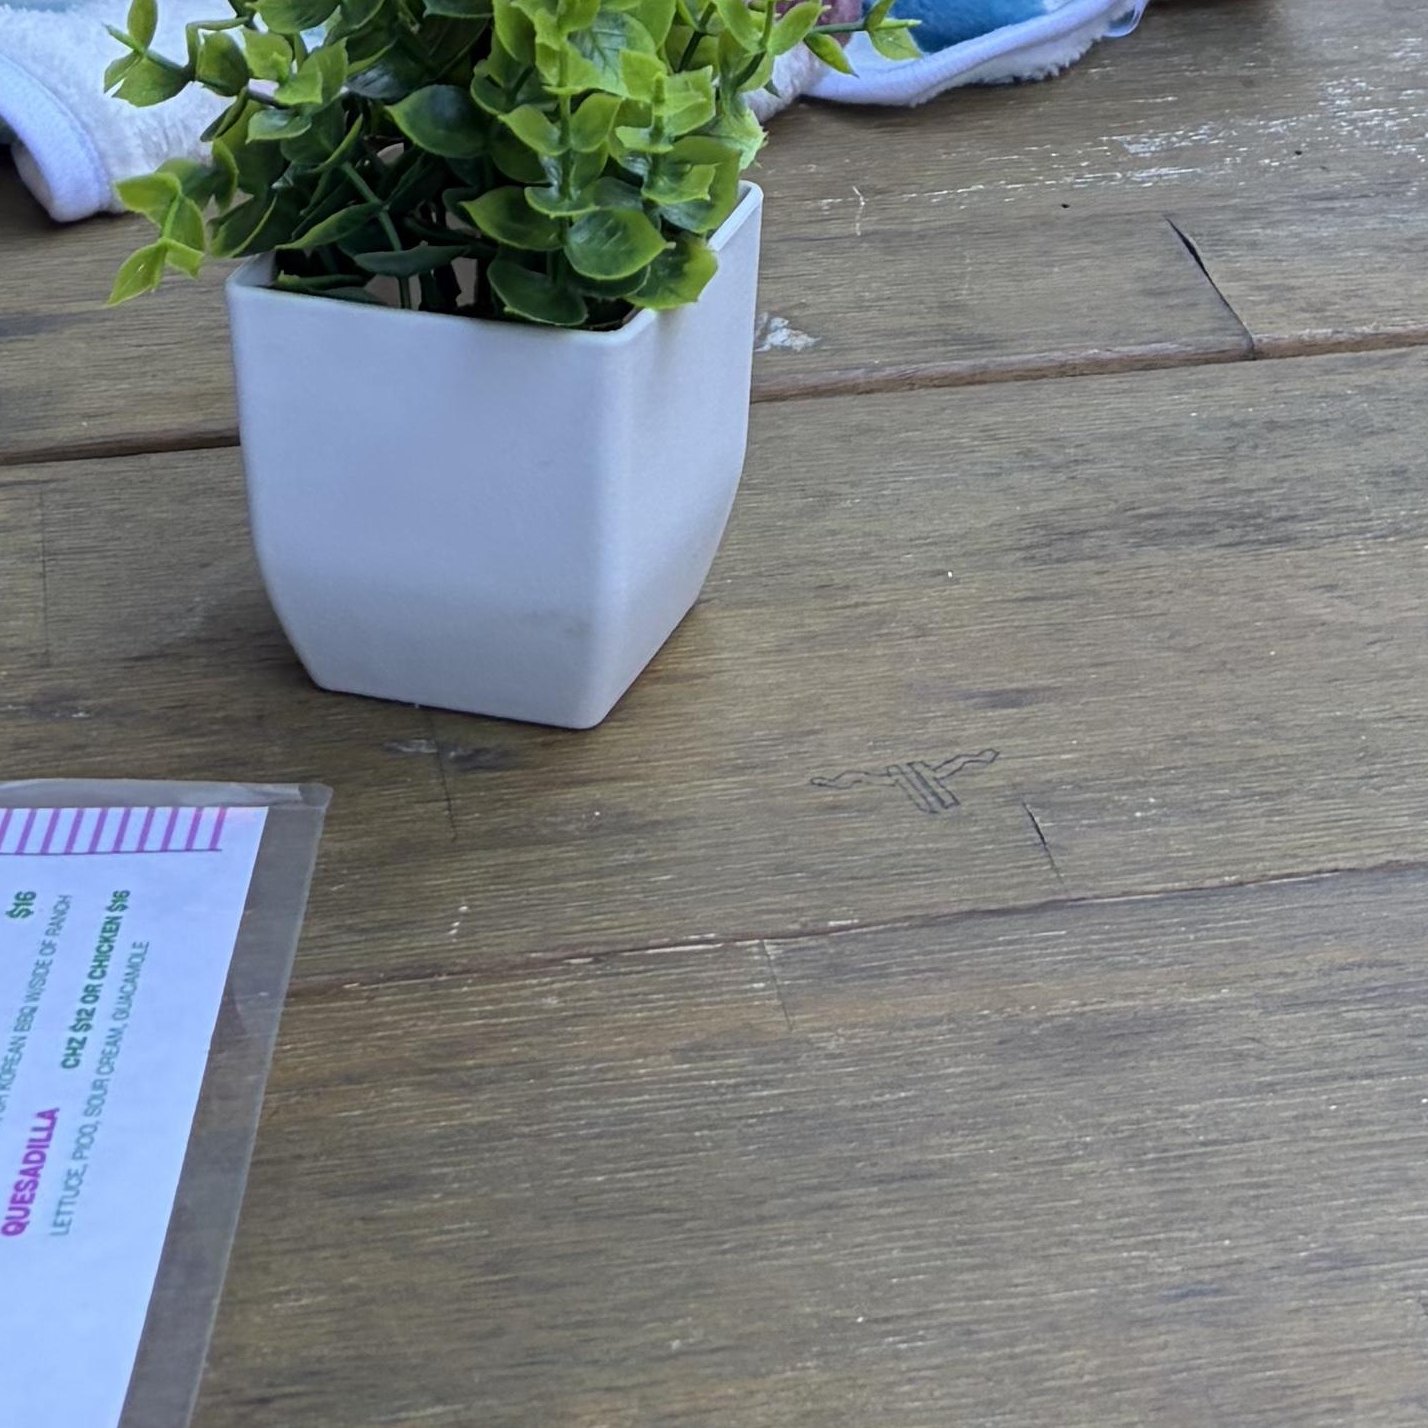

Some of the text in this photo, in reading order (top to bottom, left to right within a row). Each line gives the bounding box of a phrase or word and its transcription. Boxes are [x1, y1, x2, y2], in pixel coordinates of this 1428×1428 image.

[4, 890, 37, 919] $16
[44, 894, 73, 935] RANCH
[38, 939, 57, 956] OF
[23, 958, 54, 1001] W/SIDE
[60, 889, 131, 1068] CHZ $12 OR CHICKEN $16
[12, 1005, 39, 1031] BBQ
[48, 941, 150, 1235] LETTUCE, PICO, SOUR CREAM, GUACAMOLE
[0, 1107, 61, 1236] QUESADILLA
